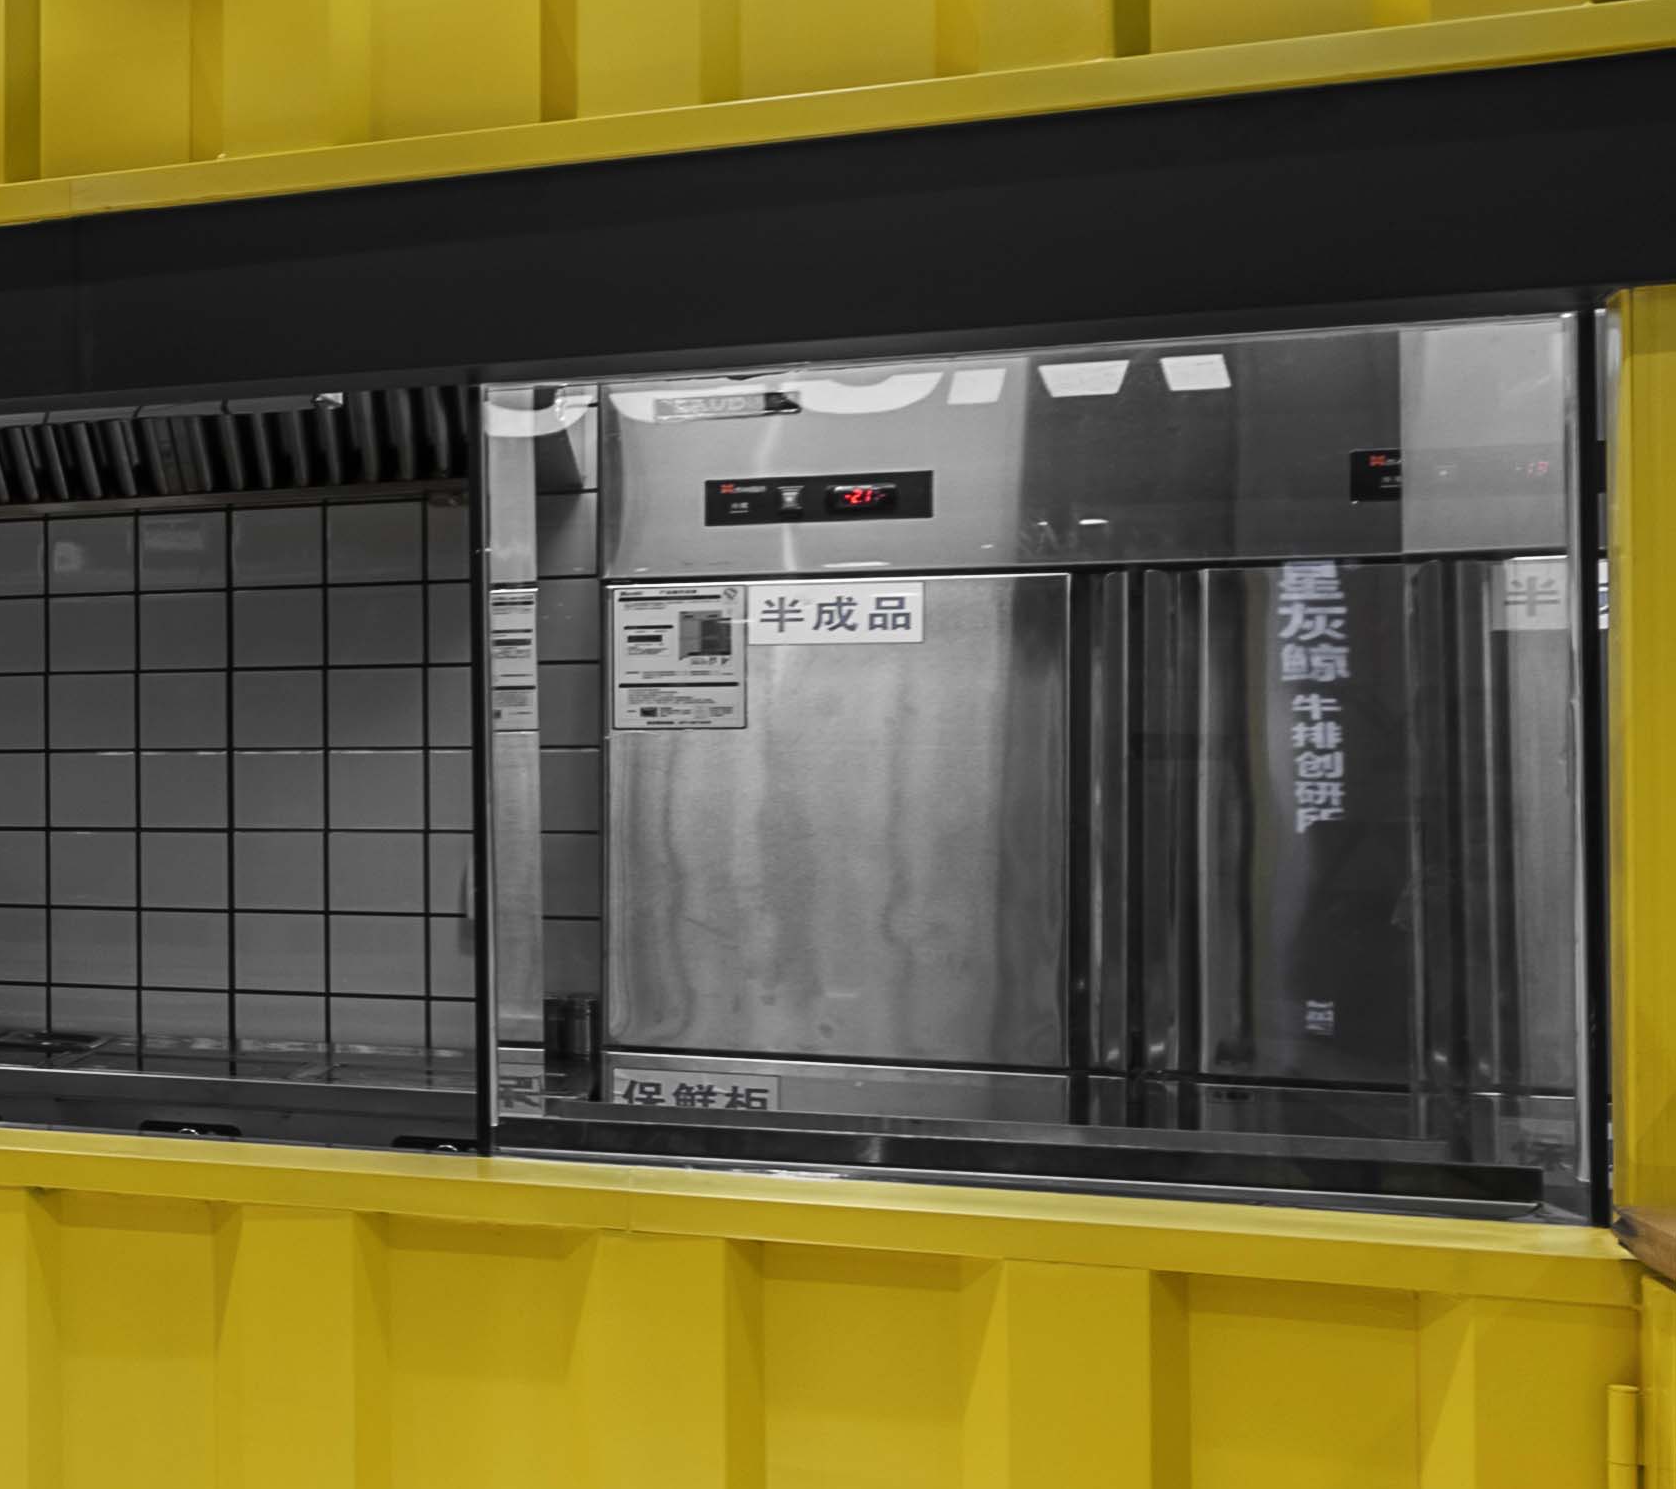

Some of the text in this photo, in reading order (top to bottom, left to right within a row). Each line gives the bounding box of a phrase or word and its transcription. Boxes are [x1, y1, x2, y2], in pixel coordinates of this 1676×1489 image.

[759, 589, 913, 635] 半成品
[621, 1079, 770, 1112] 保鲜柜
